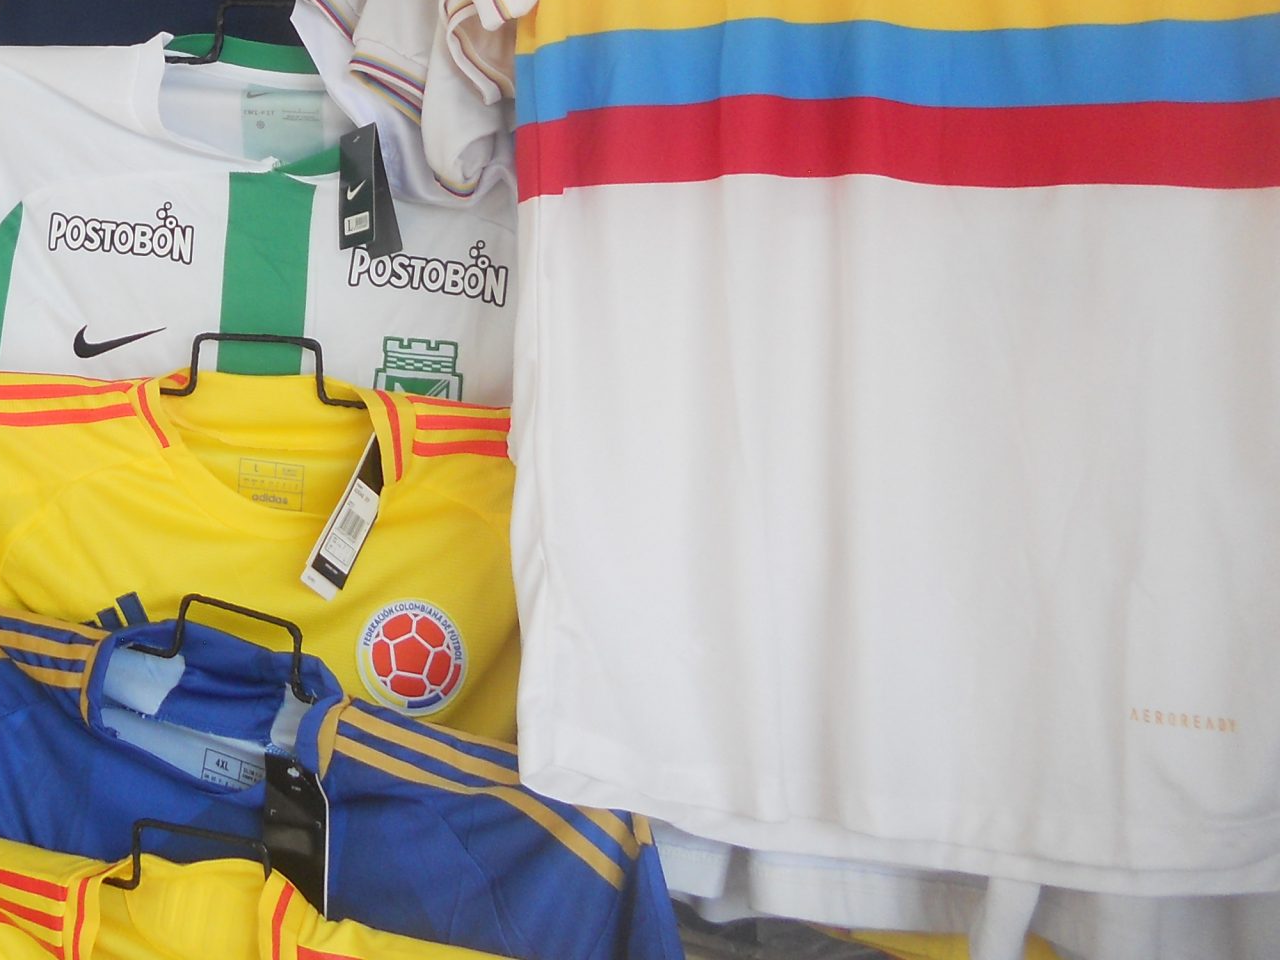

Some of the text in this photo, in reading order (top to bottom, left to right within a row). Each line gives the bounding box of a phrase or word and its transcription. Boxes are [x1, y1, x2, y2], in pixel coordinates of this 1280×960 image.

[252, 493, 288, 505] adidas
[363, 602, 463, 661] FEDERACIÓN COLOMBIANA DE FÚTBOL
[215, 758, 229, 772] 4XL
